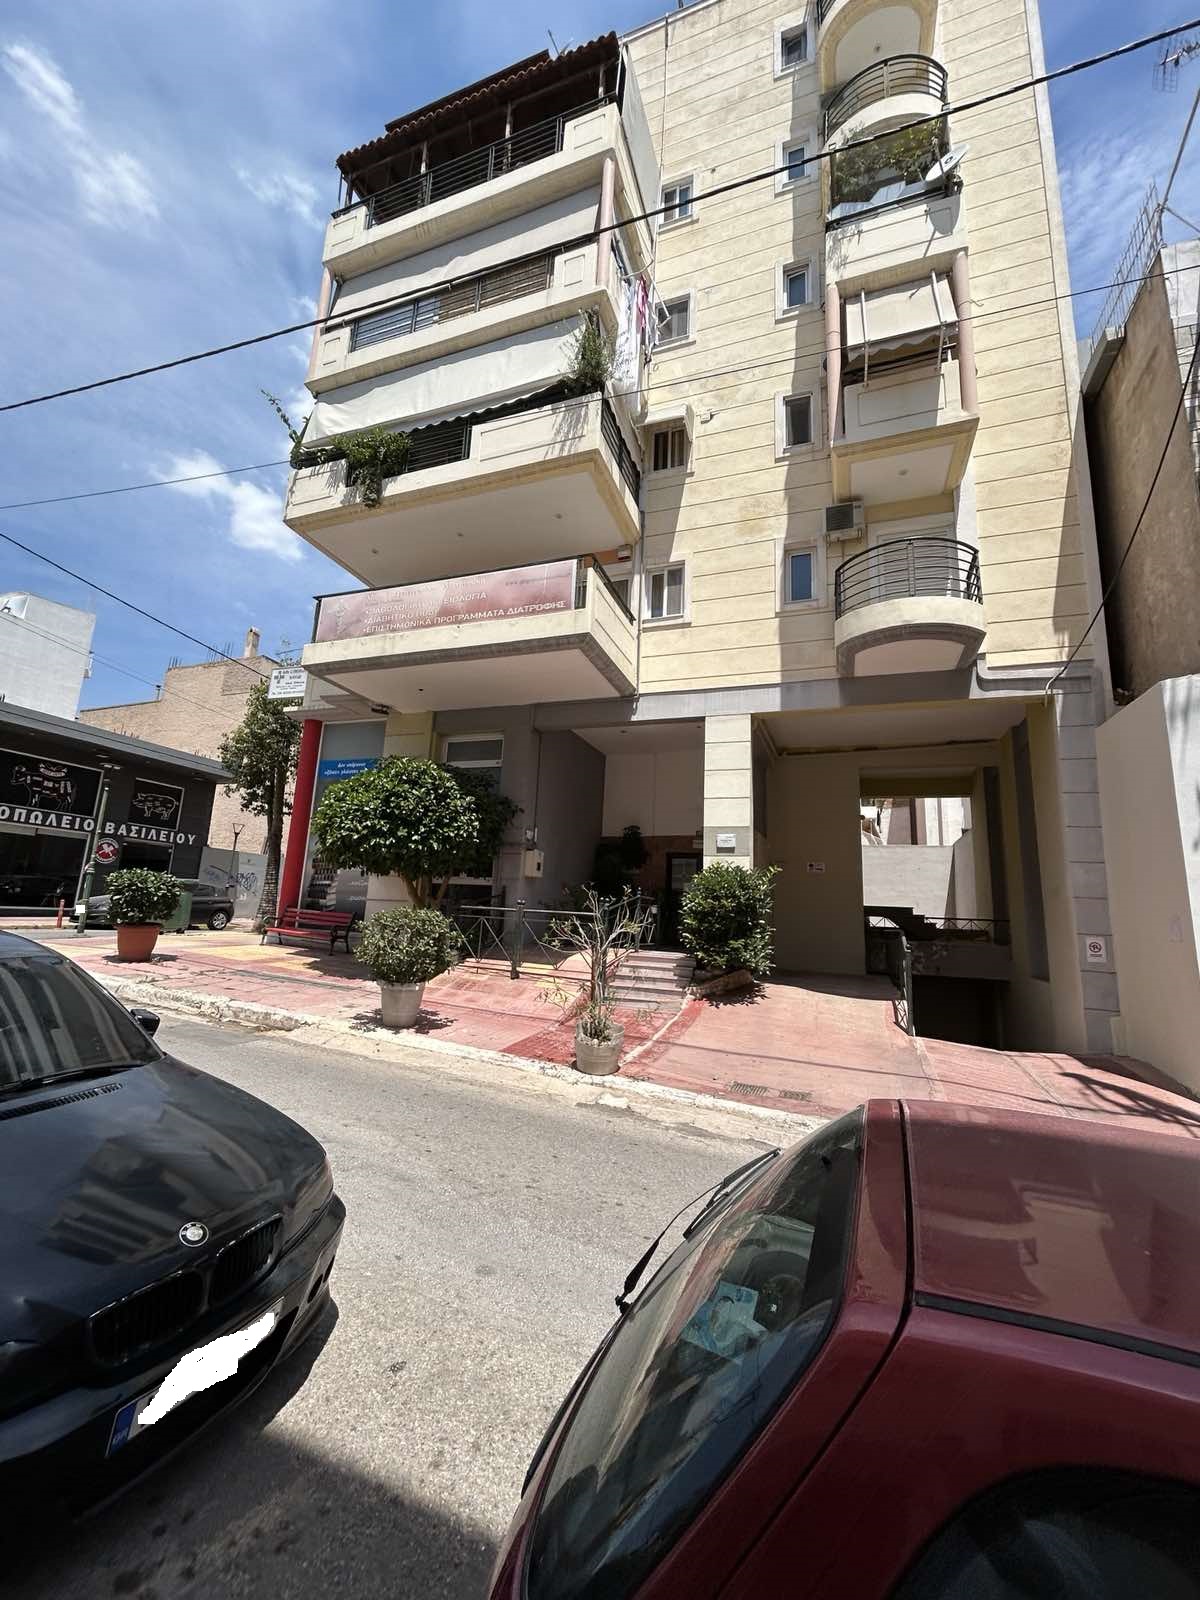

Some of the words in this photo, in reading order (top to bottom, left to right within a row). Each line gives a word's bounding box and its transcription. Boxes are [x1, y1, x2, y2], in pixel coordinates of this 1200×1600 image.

[366, 617, 432, 633] ΕΠΙΣΤΗΜΟΝΙΚΑ
[434, 608, 505, 625] ΠΡΟΓΡΑΜΜΑΤΑ
[506, 600, 567, 615] ΔΙΑΤΡΟΦΗΣ
[104, 821, 197, 846] ΒΑΣΙΛΕΙΟΥ
